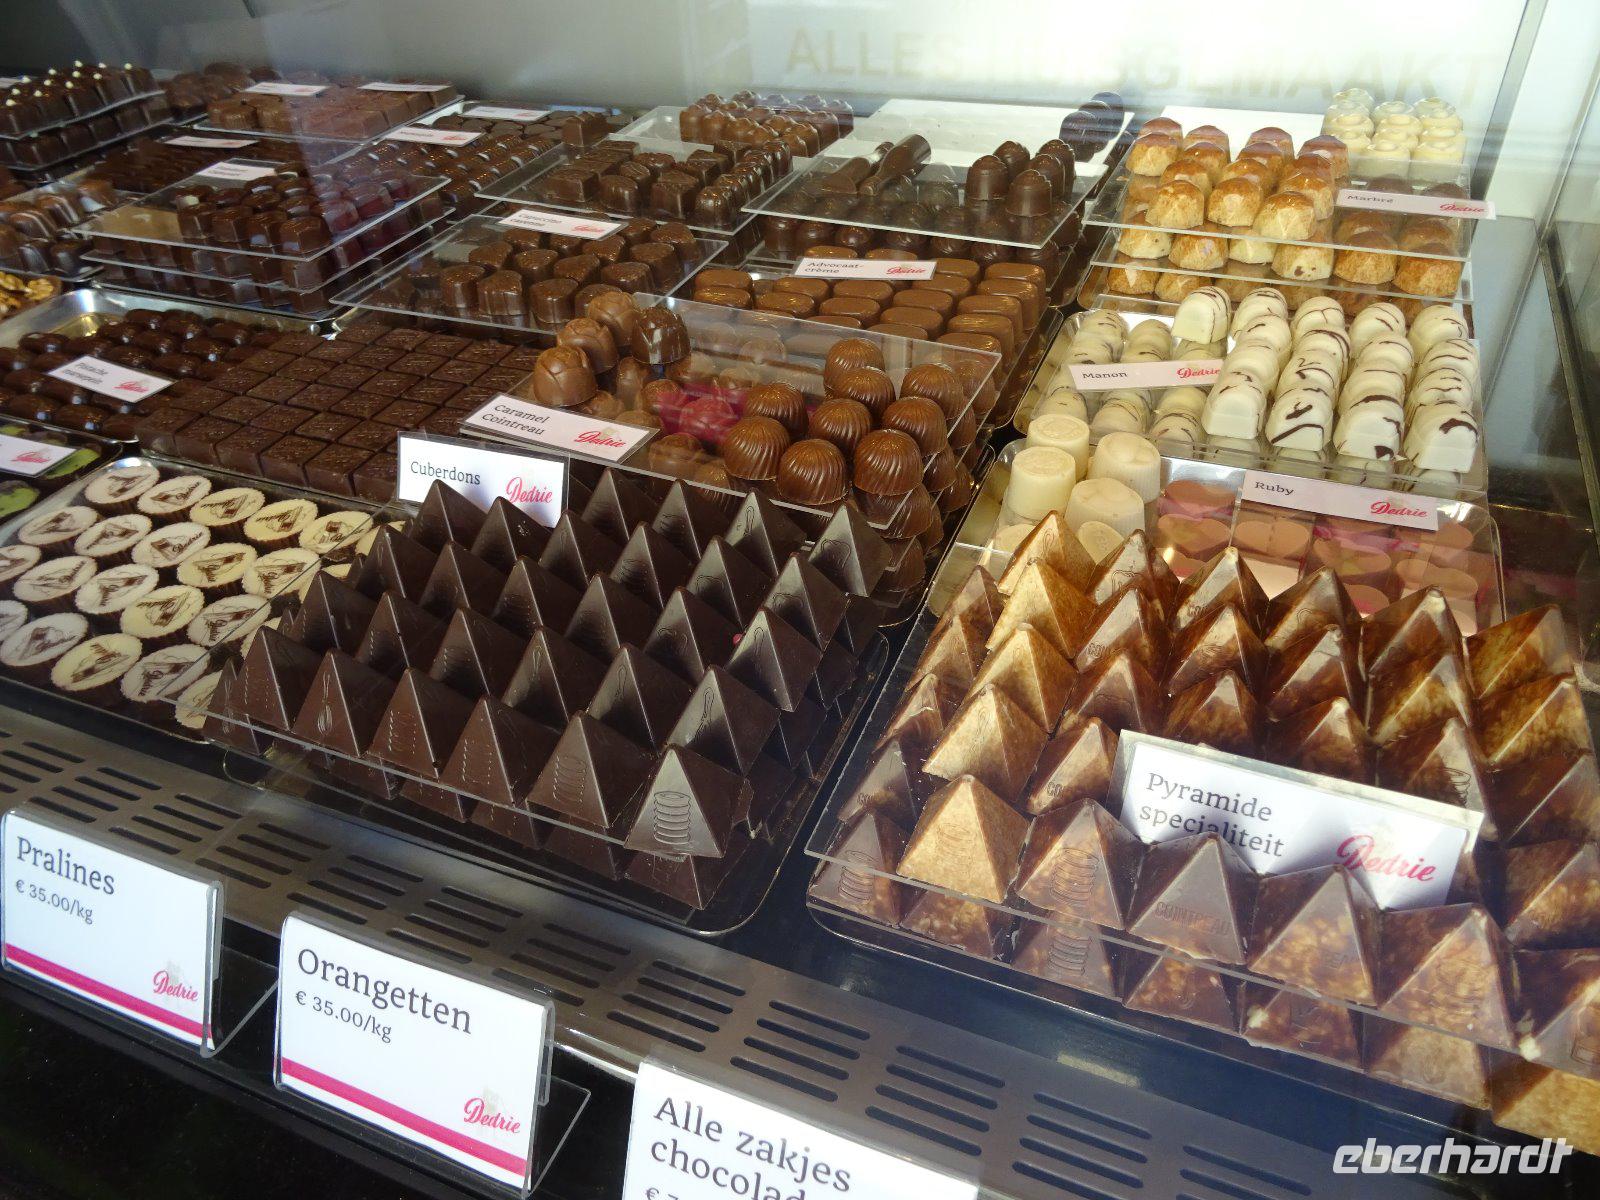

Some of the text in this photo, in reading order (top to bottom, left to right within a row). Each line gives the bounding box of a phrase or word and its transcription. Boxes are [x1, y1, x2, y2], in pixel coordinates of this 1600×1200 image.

[785, 26, 964, 82] ALLES
[1082, 371, 1128, 380] Manon
[481, 412, 546, 437] Cointreau
[493, 403, 551, 425] Caramel
[573, 430, 628, 449] Dedrie
[410, 461, 482, 486] Cuberdons
[505, 477, 554, 504] Dedrie
[1254, 480, 1295, 497] Ruby
[1370, 500, 1428, 518] Dedrie
[1145, 771, 1273, 823] Pyramide
[1138, 804, 1285, 858] specialiteit
[16, 836, 116, 896] Pralines
[1335, 834, 1438, 884] Dedrie
[15, 879, 94, 925] € 35.00/kg
[153, 970, 199, 1002] Dedrie
[297, 948, 472, 1035] Orangetten
[295, 990, 392, 1044] € 35.00/kg
[463, 1097, 522, 1134] Dedrie
[653, 1096, 852, 1193] Alle zakjes
